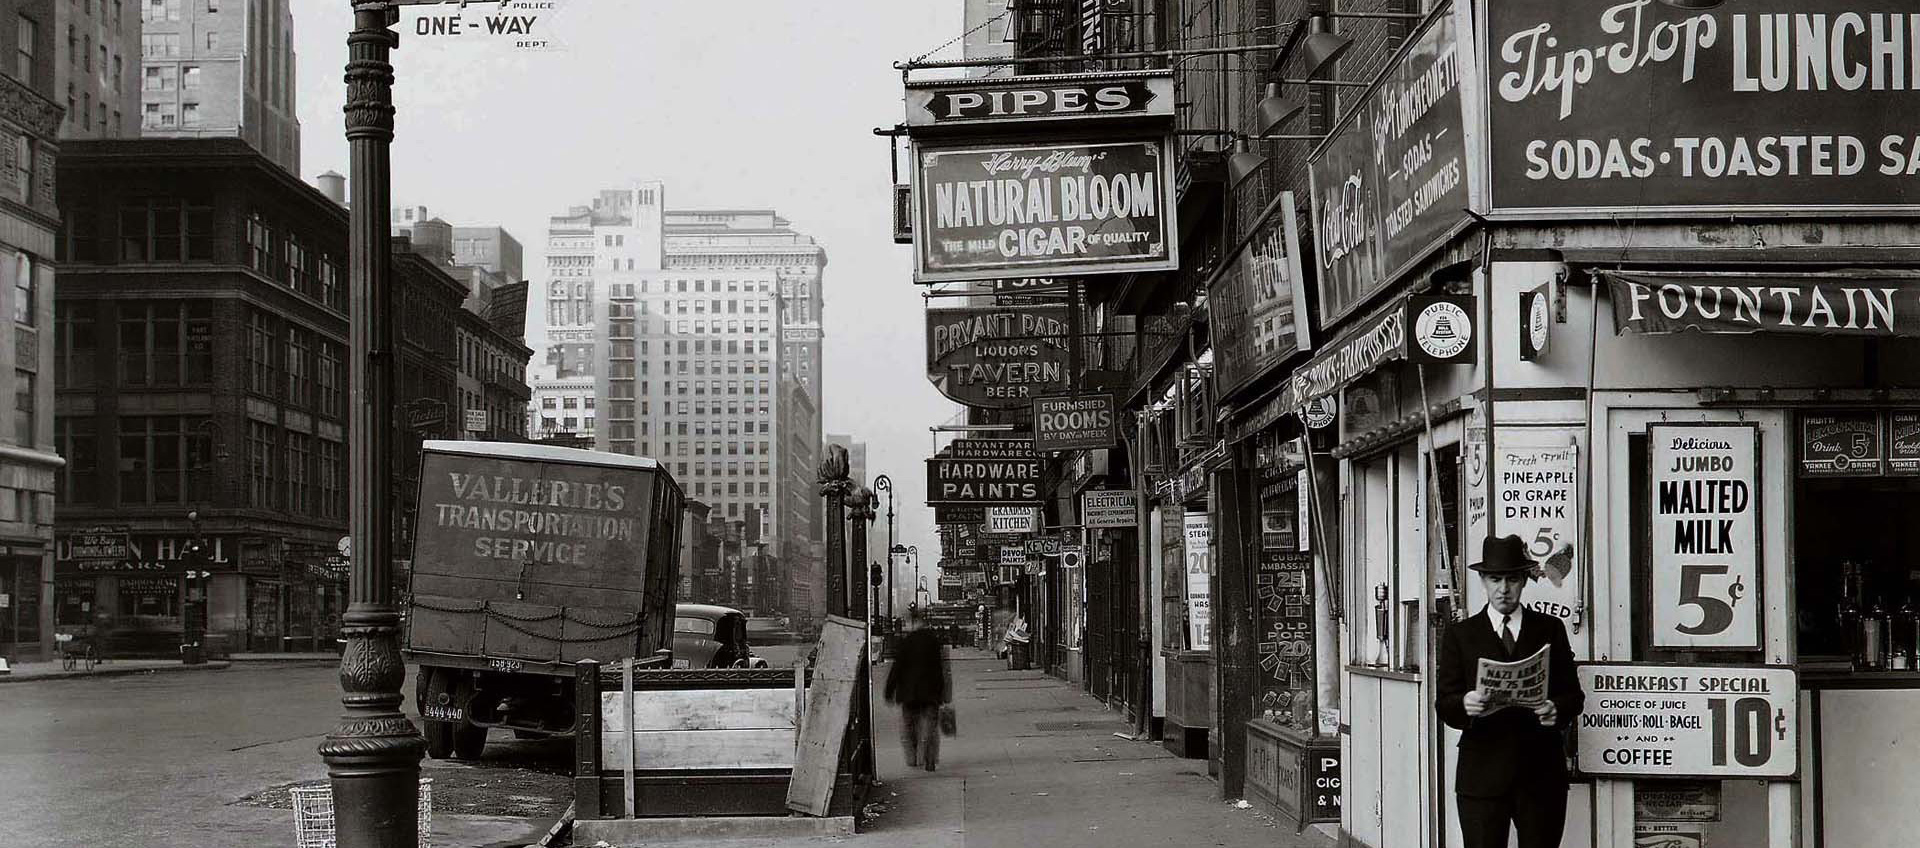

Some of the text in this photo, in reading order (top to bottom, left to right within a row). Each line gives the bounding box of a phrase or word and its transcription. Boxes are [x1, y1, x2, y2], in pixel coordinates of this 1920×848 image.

[416, 16, 461, 35] ONE
[486, 16, 537, 35] WAY
[946, 86, 1130, 118] PIPES
[1402, 132, 1432, 181] SODAS
[980, 153, 1041, 180] Harry
[935, 172, 1155, 228] NATURAL BLOOM
[1385, 157, 1460, 241] TOASTED SANDWICHES
[943, 226, 1150, 258] THE MILD CIGAR OF QUALITY
[1424, 303, 1462, 317] PUBLIC
[1627, 283, 1898, 333] FOUNTAIN
[934, 313, 1016, 363] BRYANT
[1420, 335, 1468, 357] TELEPHONE
[976, 344, 1039, 357] LIQUORS
[950, 361, 1062, 386] TAVERN
[986, 386, 1029, 397] BEER
[1042, 400, 1106, 412] FURNISHED
[1040, 410, 1111, 431] ROOMS
[1044, 432, 1057, 440] BY
[1060, 431, 1075, 440] DAY
[1082, 429, 1107, 438] WEEK
[1670, 437, 1732, 450] Delicious
[1812, 440, 1842, 452] Drink
[1506, 450, 1569, 466] Fresh Fruit
[1671, 456, 1733, 472] JUMBO
[939, 463, 1039, 480] HARDWARE
[1504, 471, 1573, 484] PINEAPPLE
[449, 472, 625, 512] VALLERIE'S
[943, 483, 1038, 499] PAINTS
[1503, 490, 1567, 501] OR GRAPE
[1659, 480, 1749, 514] MALTED
[1087, 496, 1136, 508] ELECTRICIAN
[1505, 506, 1565, 518] DRINK
[435, 503, 632, 541] TRANSPORTATION
[992, 517, 1031, 530] KITCHEN
[1674, 520, 1734, 554] MILK
[474, 537, 587, 565] SERVICE
[1675, 565, 1744, 636] 5¢
[1274, 622, 1308, 630] OLD
[1505, 680, 1518, 689] 75
[1594, 674, 1770, 692] BREAKFAST SPECIAL
[1600, 700, 1687, 710] CHOICE OF JUICE
[1635, 735, 1659, 743] AND
[1602, 748, 1673, 766] COFFEE
